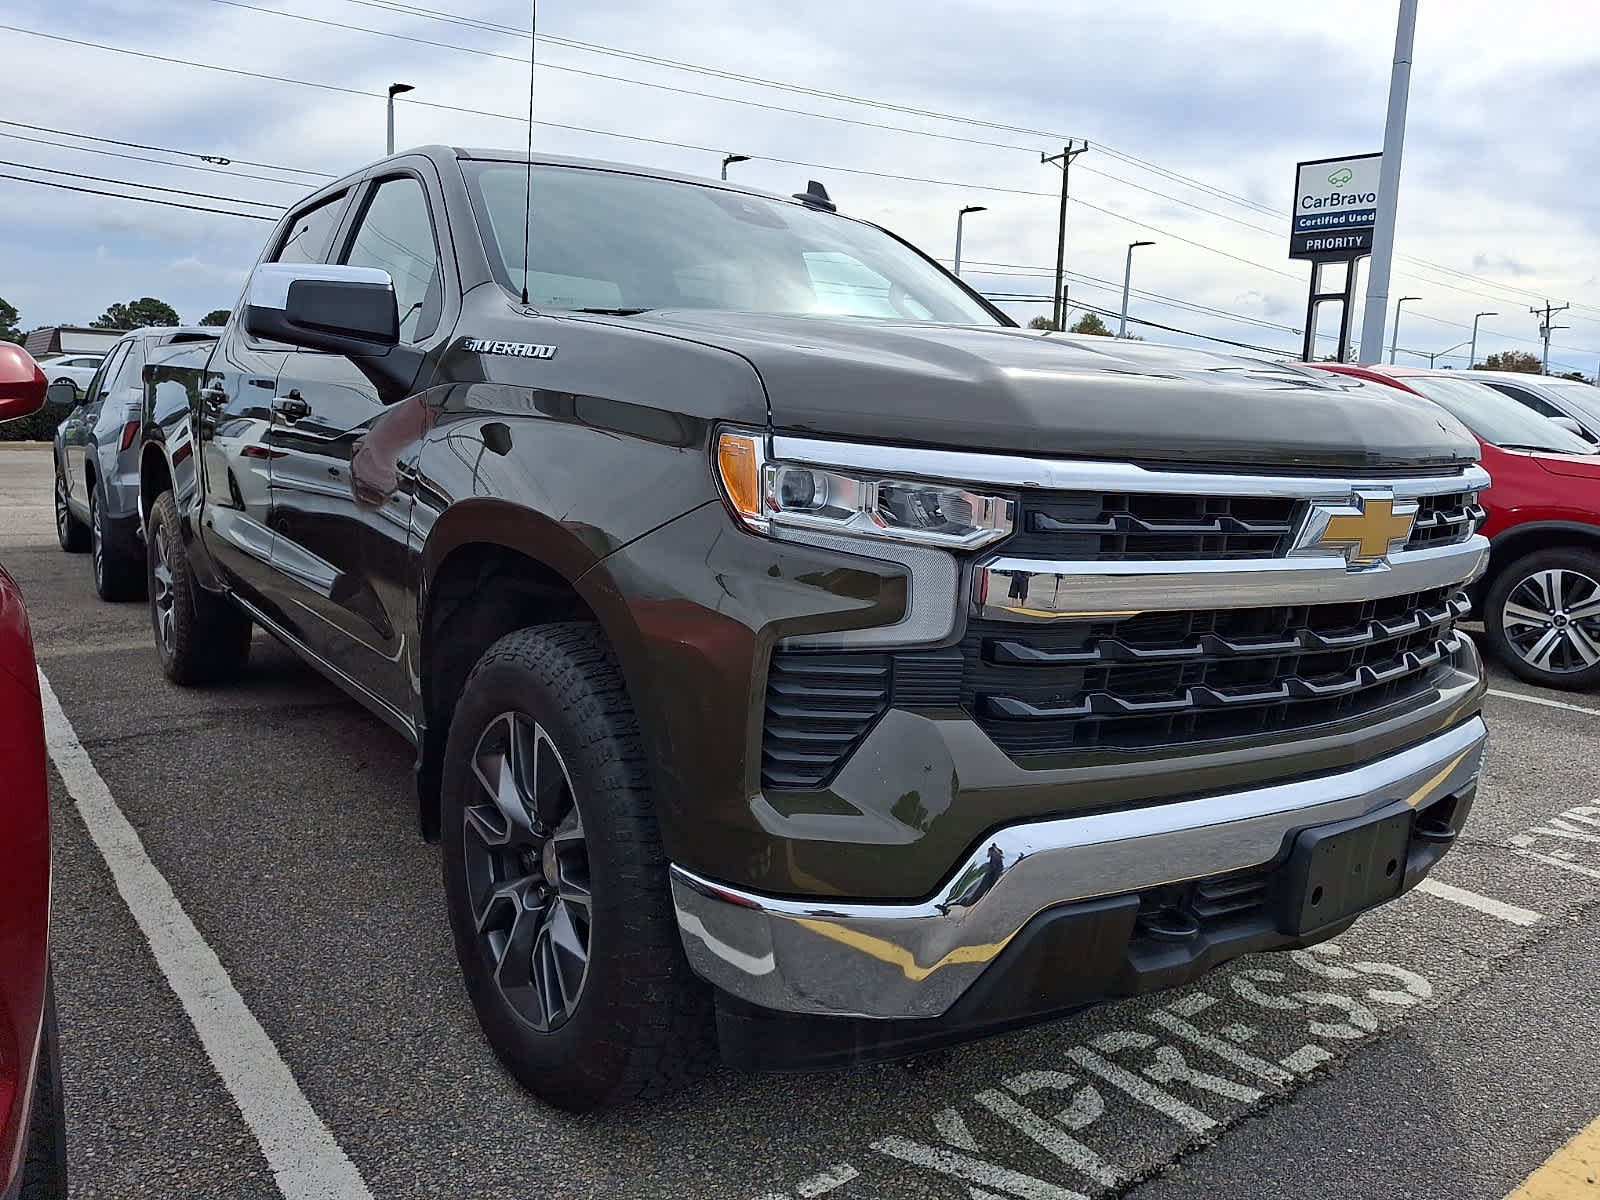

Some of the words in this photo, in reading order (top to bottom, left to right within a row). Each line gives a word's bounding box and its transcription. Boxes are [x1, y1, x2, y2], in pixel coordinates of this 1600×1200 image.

[1302, 192, 1376, 209] CarBravo
[1300, 215, 1346, 227] Certified
[1348, 212, 1375, 223] Used
[1306, 236, 1363, 250] PRIORITY
[464, 339, 557, 359] SILVERADO
[750, 943, 1432, 1200] XPRESS
